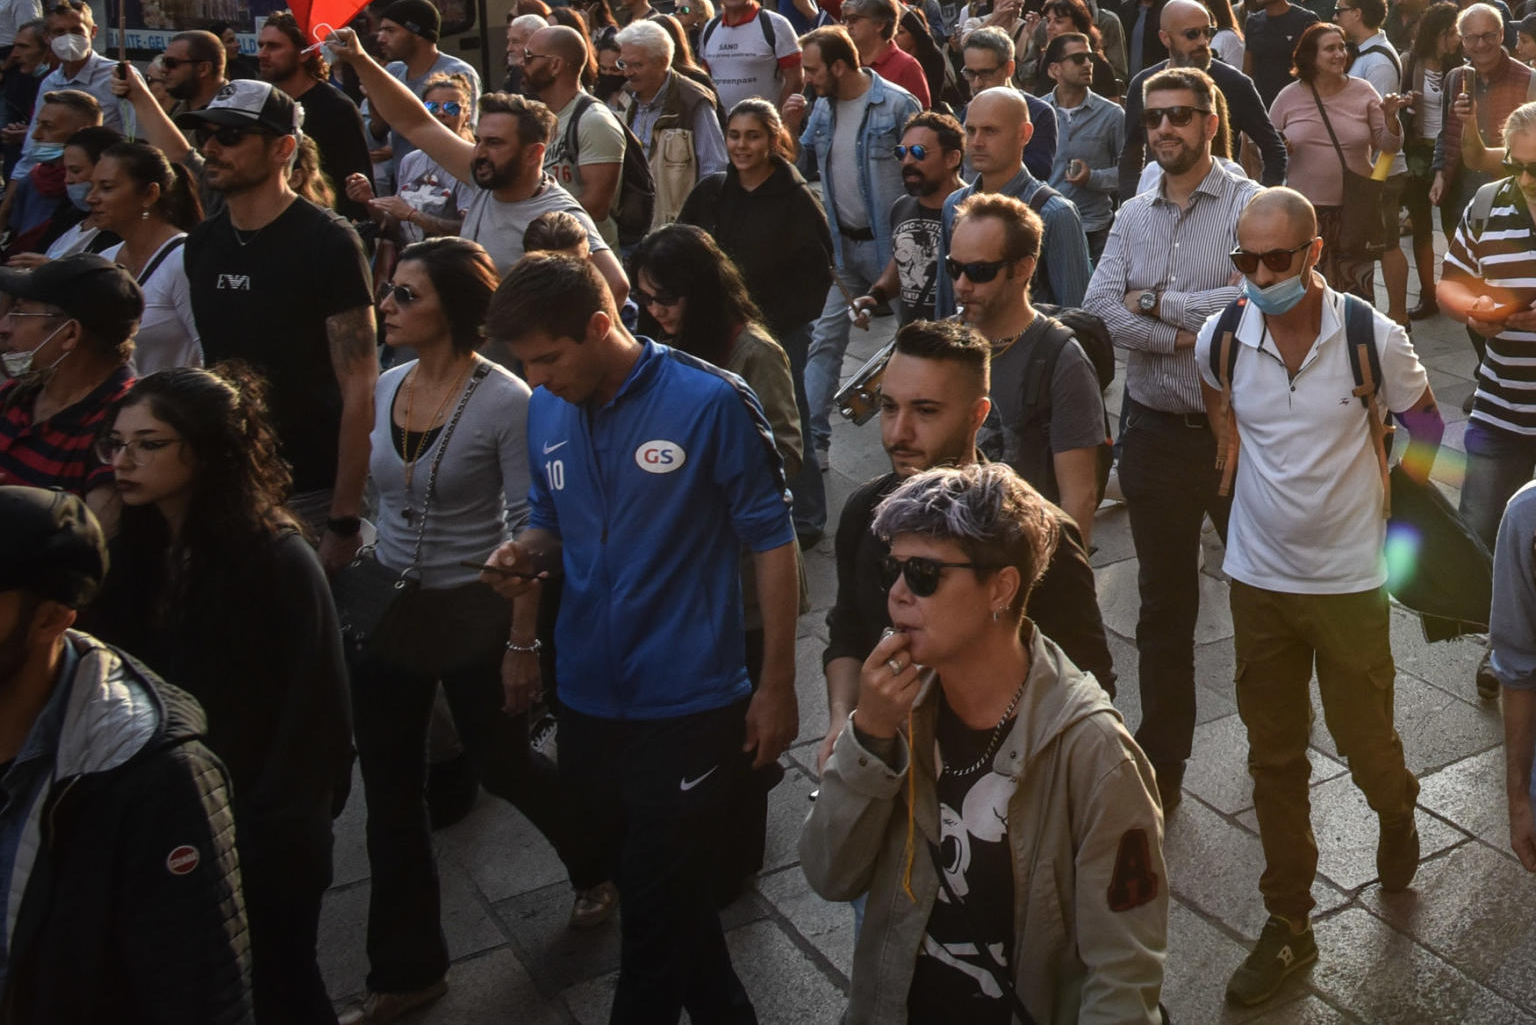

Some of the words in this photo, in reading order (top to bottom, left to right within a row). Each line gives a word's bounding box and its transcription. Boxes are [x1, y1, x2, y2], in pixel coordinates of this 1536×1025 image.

[644, 448, 674, 465] GS
[545, 459, 565, 491] 10
[1107, 828, 1159, 913] A
